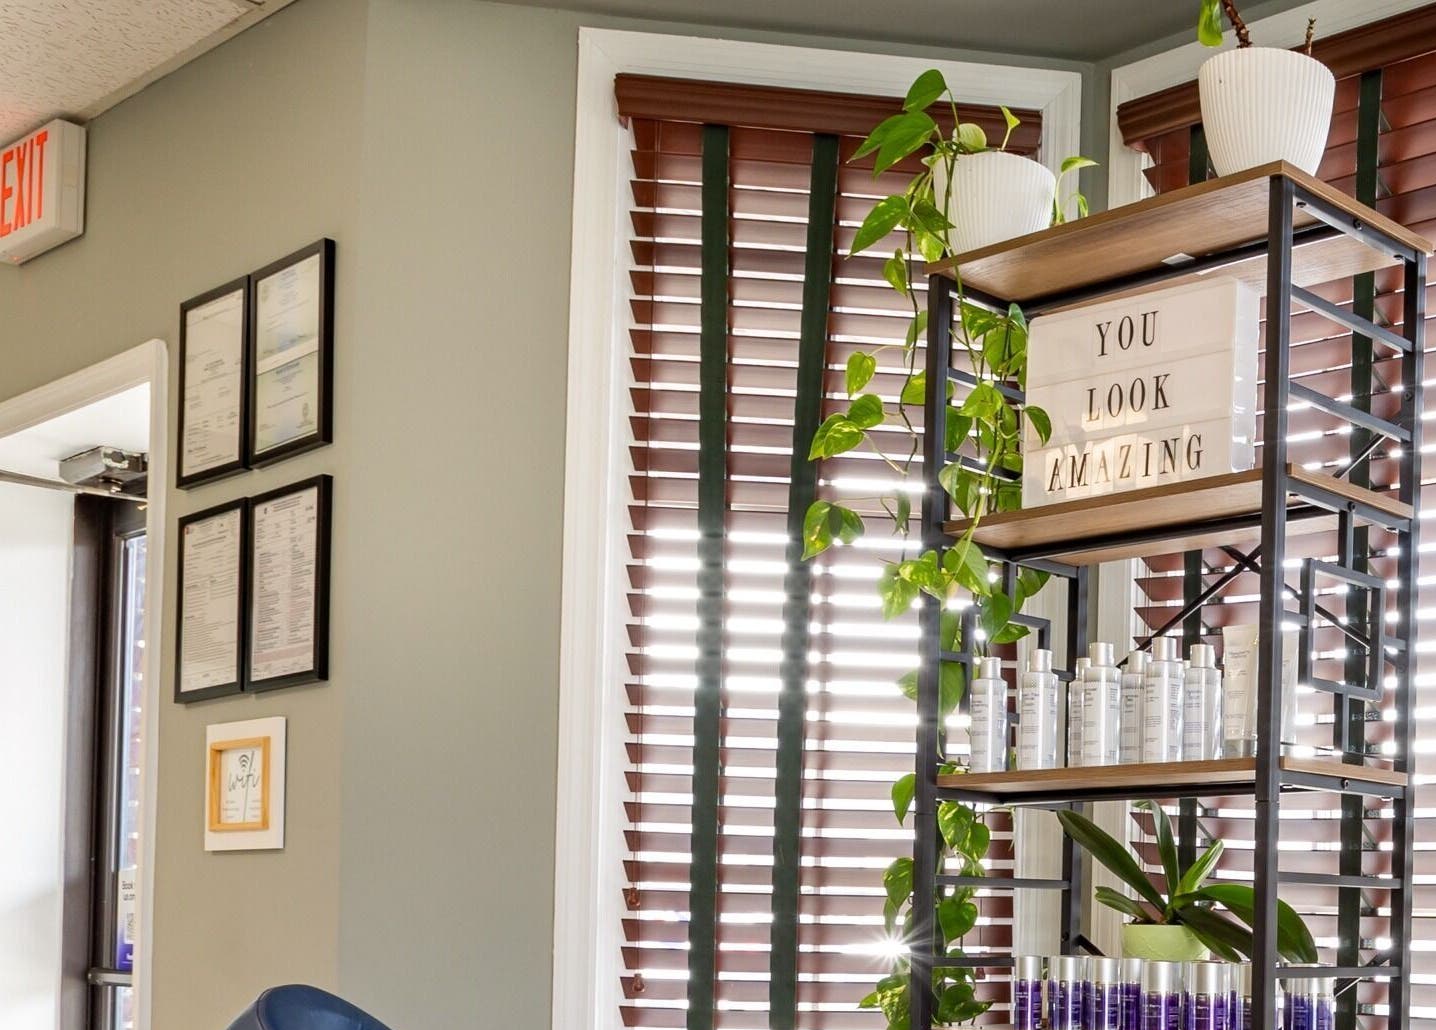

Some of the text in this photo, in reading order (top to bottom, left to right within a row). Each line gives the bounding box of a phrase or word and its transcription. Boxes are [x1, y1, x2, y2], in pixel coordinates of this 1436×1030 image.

[0, 130, 48, 238] EXIT
[1096, 311, 1159, 357] YOU
[1086, 373, 1171, 423] LOOK
[1047, 434, 1203, 492] AMAZING
